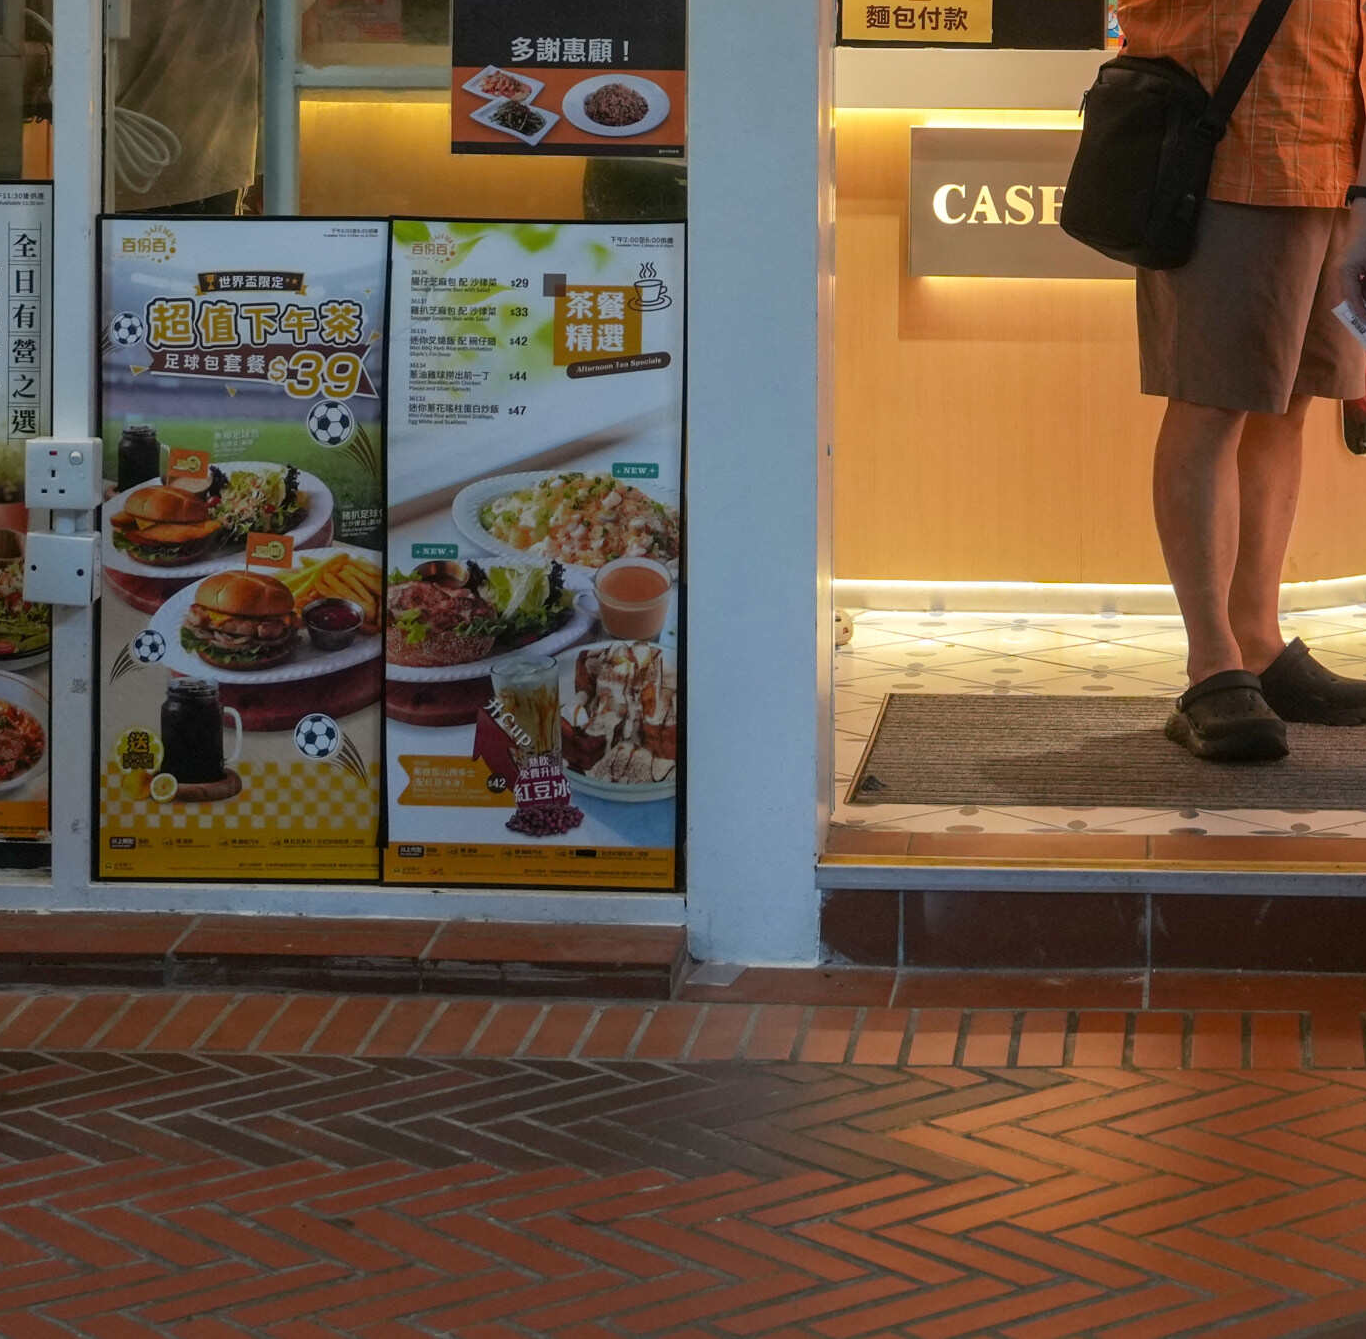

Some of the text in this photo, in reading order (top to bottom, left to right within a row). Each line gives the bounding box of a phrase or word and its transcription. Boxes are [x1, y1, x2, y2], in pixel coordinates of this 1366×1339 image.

[866, 5, 968, 31] 麵包付款
[122, 238, 166, 252] 百份百
[219, 276, 284, 289] 世界盃限定
[511, 278, 529, 288] $29
[510, 307, 528, 317] $33
[566, 291, 625, 320] 茶餐
[149, 300, 365, 347] 超值下午茶
[11, 234, 37, 434] 全日有營之選
[566, 323, 625, 352] 精選
[510, 336, 528, 346] $42
[164, 353, 266, 374] 足球包套餐
[267, 351, 362, 399] $39
[509, 371, 527, 381] $44
[508, 405, 527, 415] $47
[623, 466, 648, 475] NEW
[422, 547, 450, 556] NEW
[488, 777, 506, 788] $42
[514, 779, 571, 802] 紅豆冰
